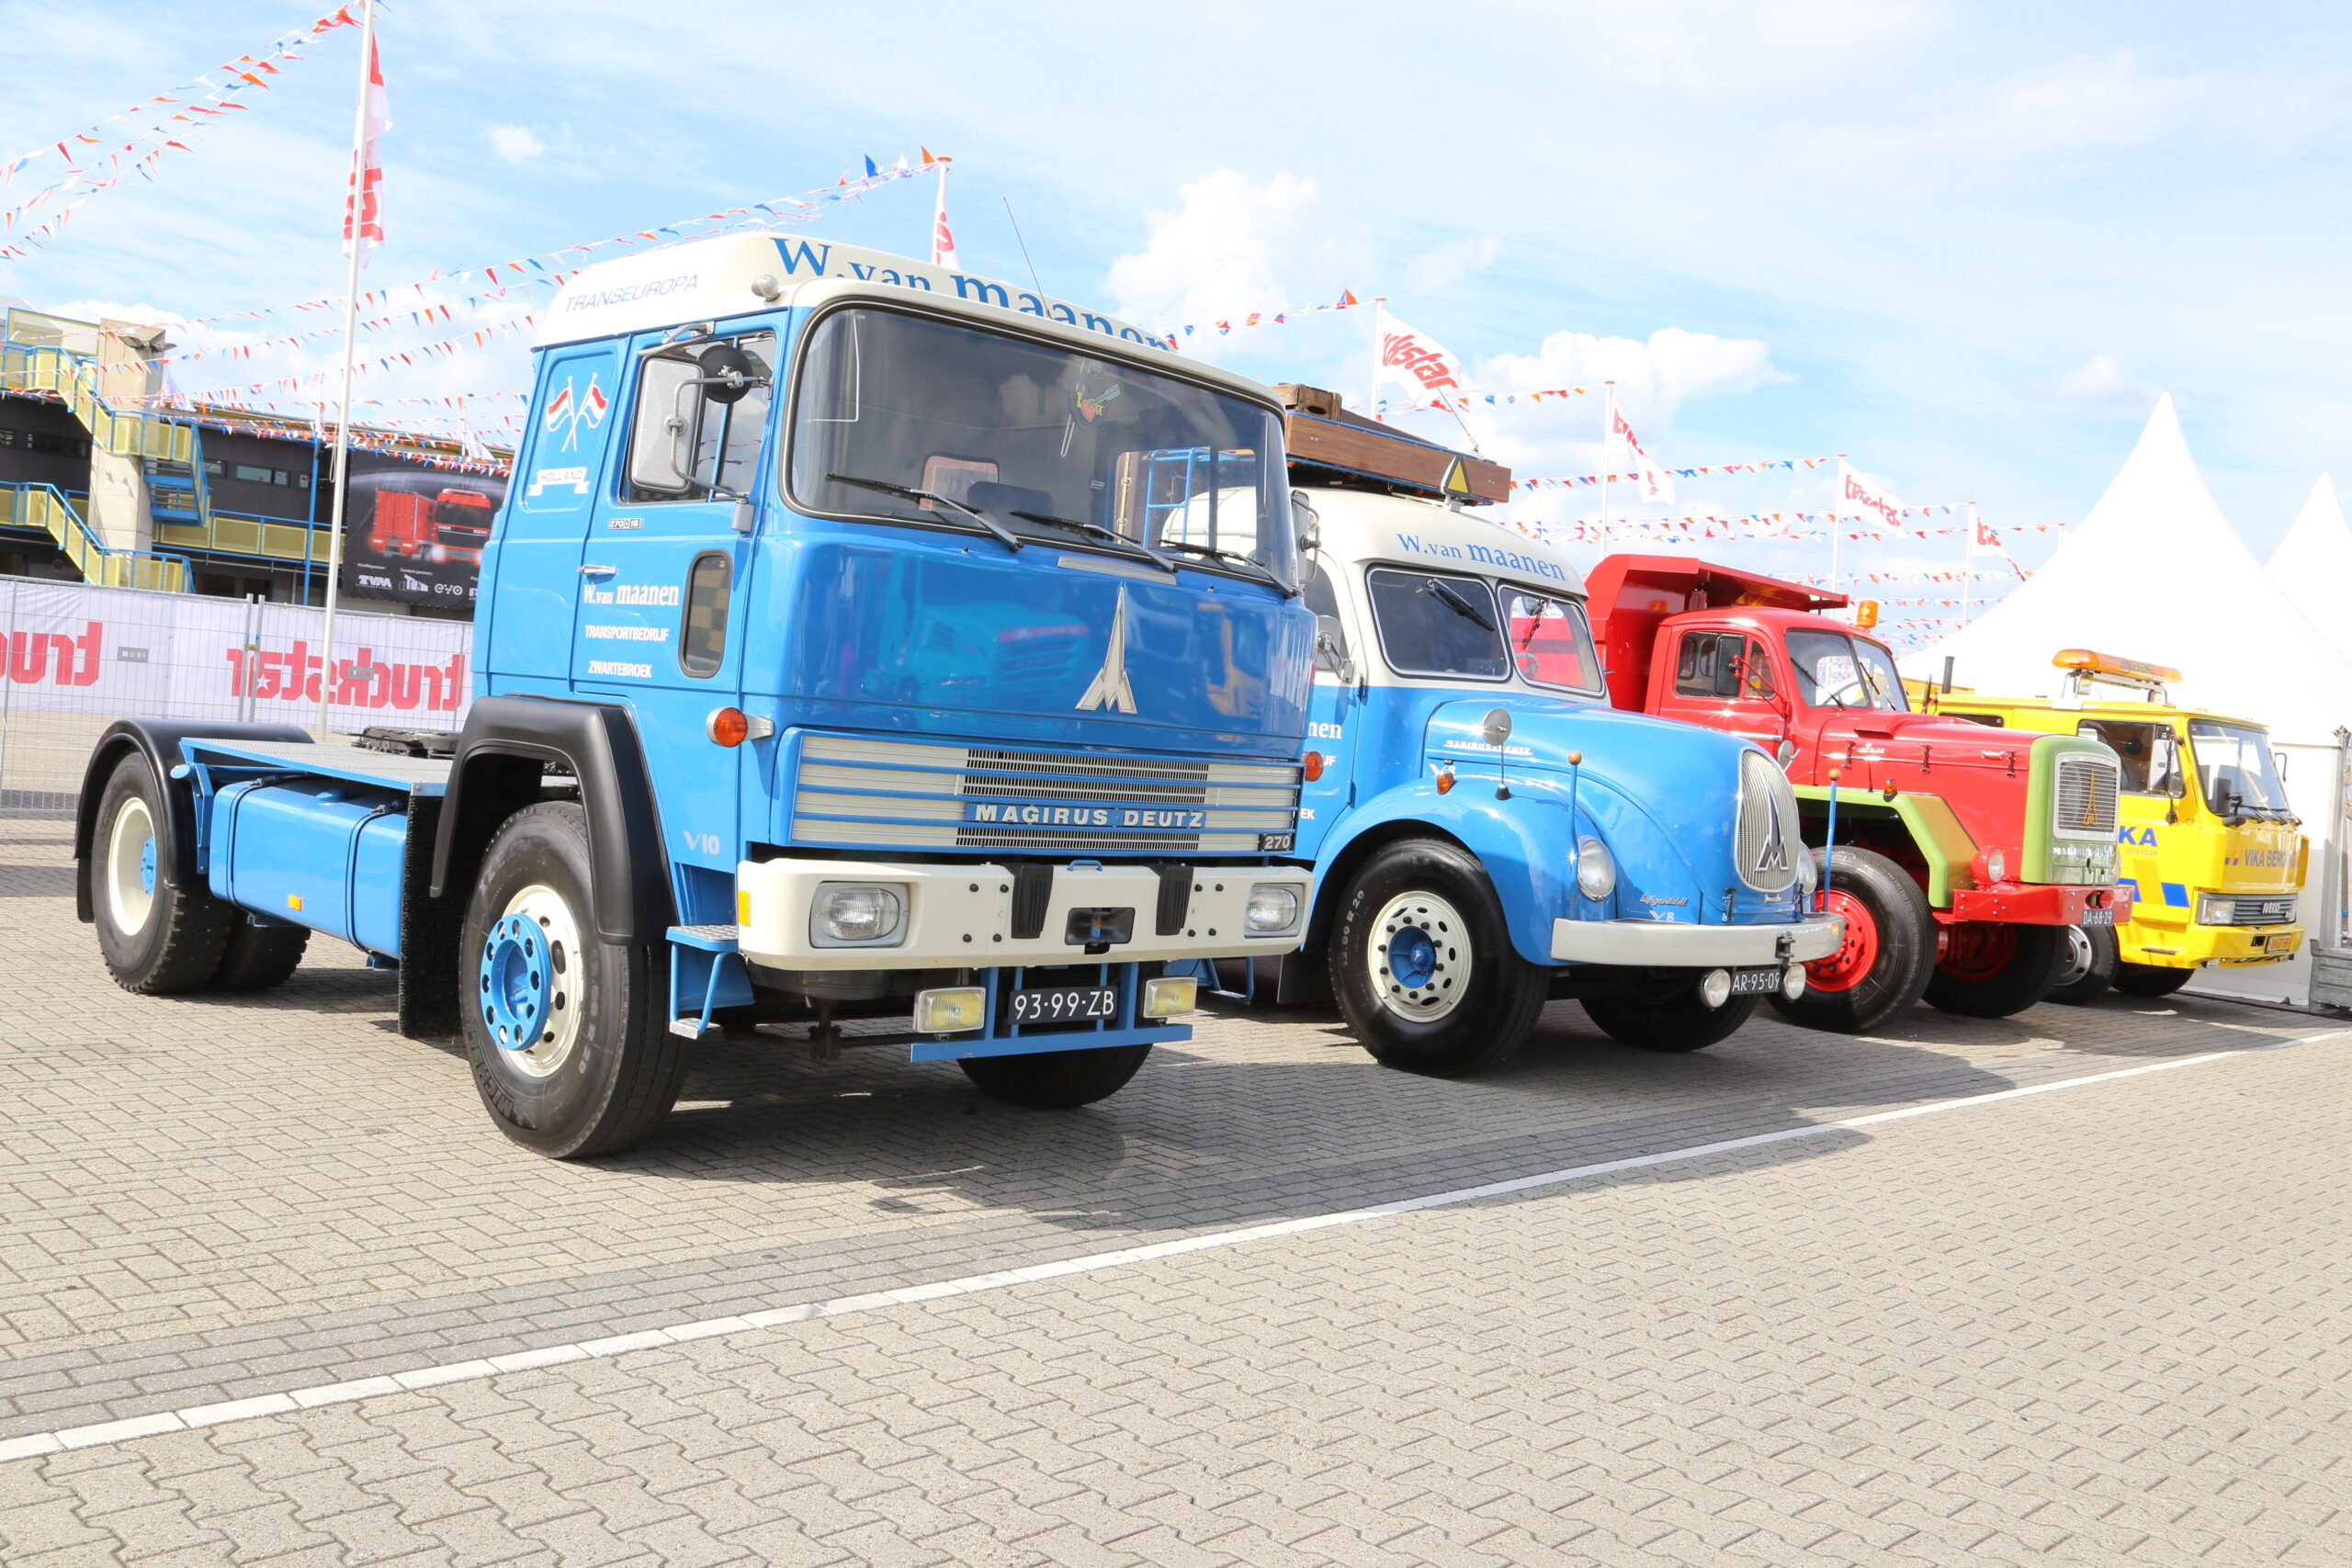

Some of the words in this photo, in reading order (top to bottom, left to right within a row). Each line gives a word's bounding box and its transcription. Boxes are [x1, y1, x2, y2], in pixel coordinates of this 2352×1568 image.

[566, 274, 697, 312] TRANSEUROPA
[540, 469, 582, 482] HOLLAND
[1465, 543, 1566, 581] maanen
[357, 574, 392, 588] TVM
[434, 582, 463, 595] evo
[616, 584, 679, 605] maanen
[585, 625, 669, 642] TRANSPORTBEDRIJF
[589, 660, 651, 678] ZWARTEBROEK
[975, 804, 1108, 826] MAGIRUS
[1124, 811, 1204, 828] DEUTZ
[683, 830, 720, 855] V10
[1264, 835, 1291, 850] 270
[2119, 826, 2157, 847] KA
[2245, 849, 2265, 867] VIKA
[1352, 890, 1364, 909] 20
[2262, 902, 2280, 915] IVECO
